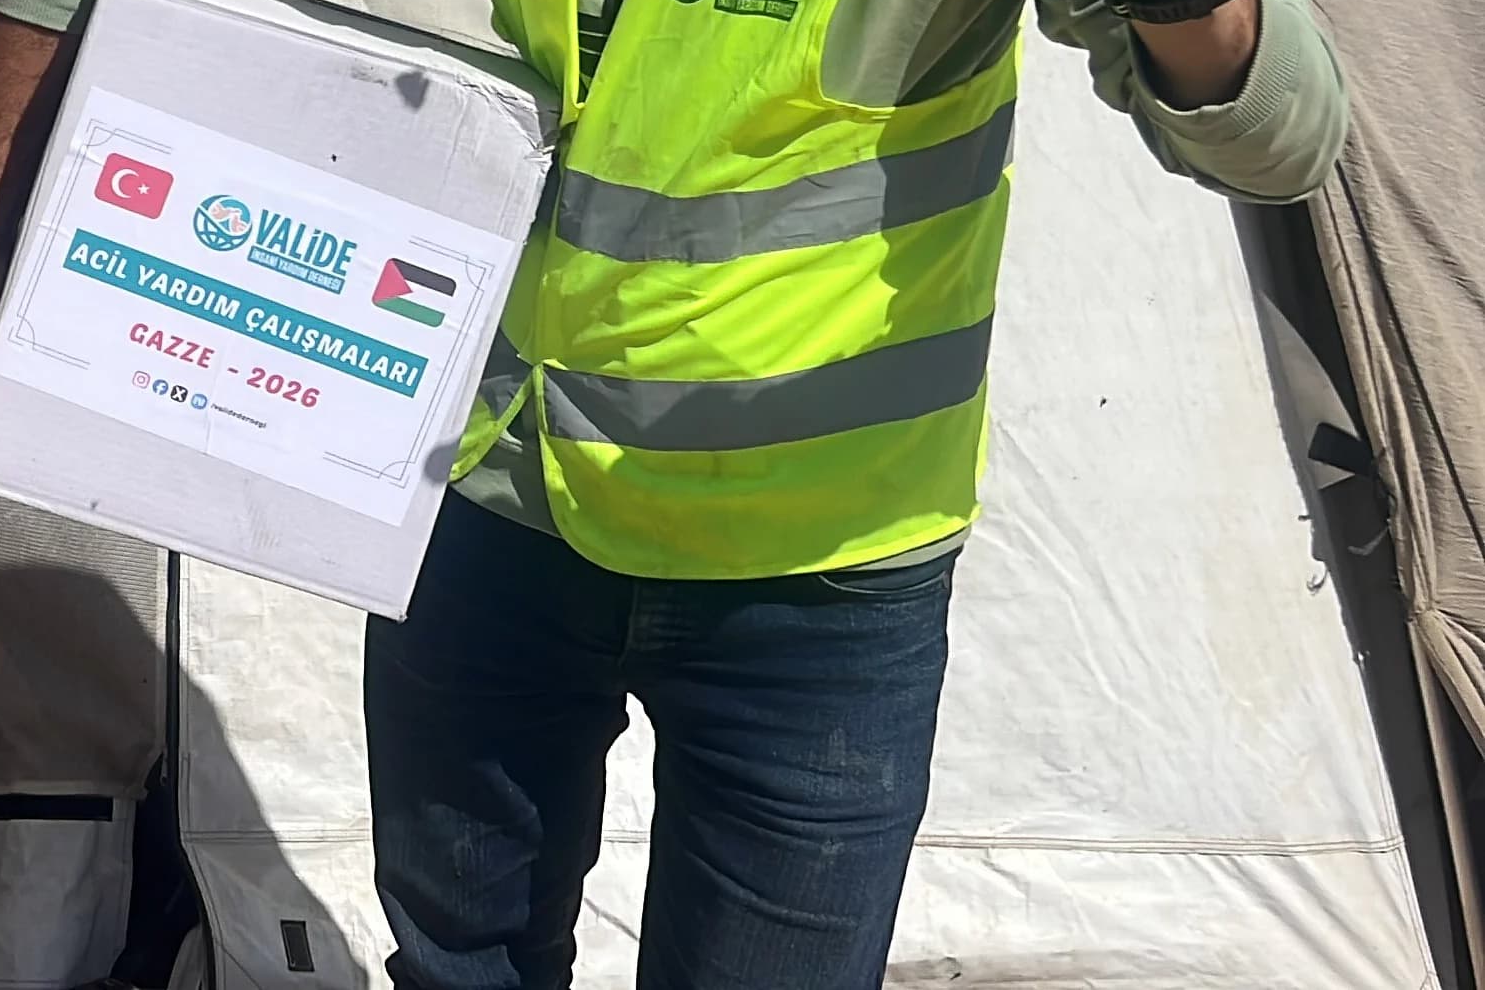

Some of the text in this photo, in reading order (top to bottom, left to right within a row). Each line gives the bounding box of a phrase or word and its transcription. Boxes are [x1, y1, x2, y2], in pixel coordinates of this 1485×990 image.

[70, 243, 419, 387] ACİL YARDIM ÇALIŞMALARI
[129, 323, 215, 369] GAZZE
[246, 367, 321, 408] 2026
